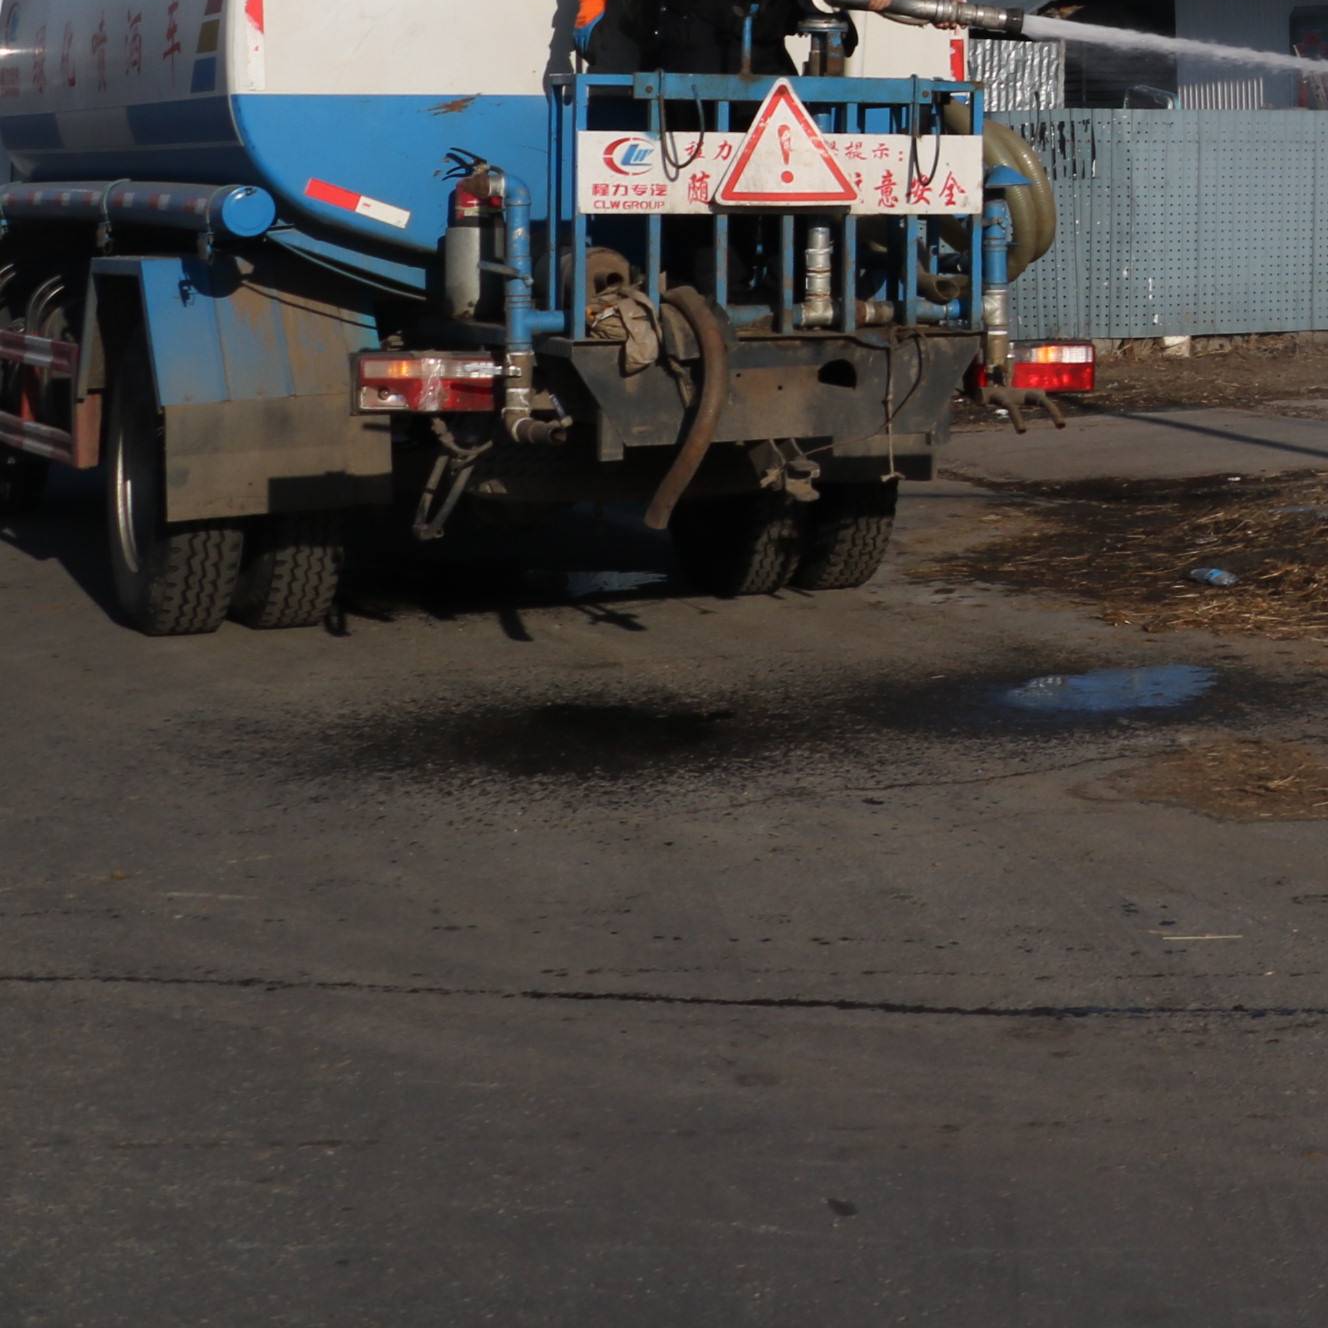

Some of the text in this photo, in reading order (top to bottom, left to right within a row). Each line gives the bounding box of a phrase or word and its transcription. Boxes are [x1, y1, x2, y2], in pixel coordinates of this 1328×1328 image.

[591, 183, 668, 197] 程力专汽
[593, 199, 666, 210] CLW GROUP
